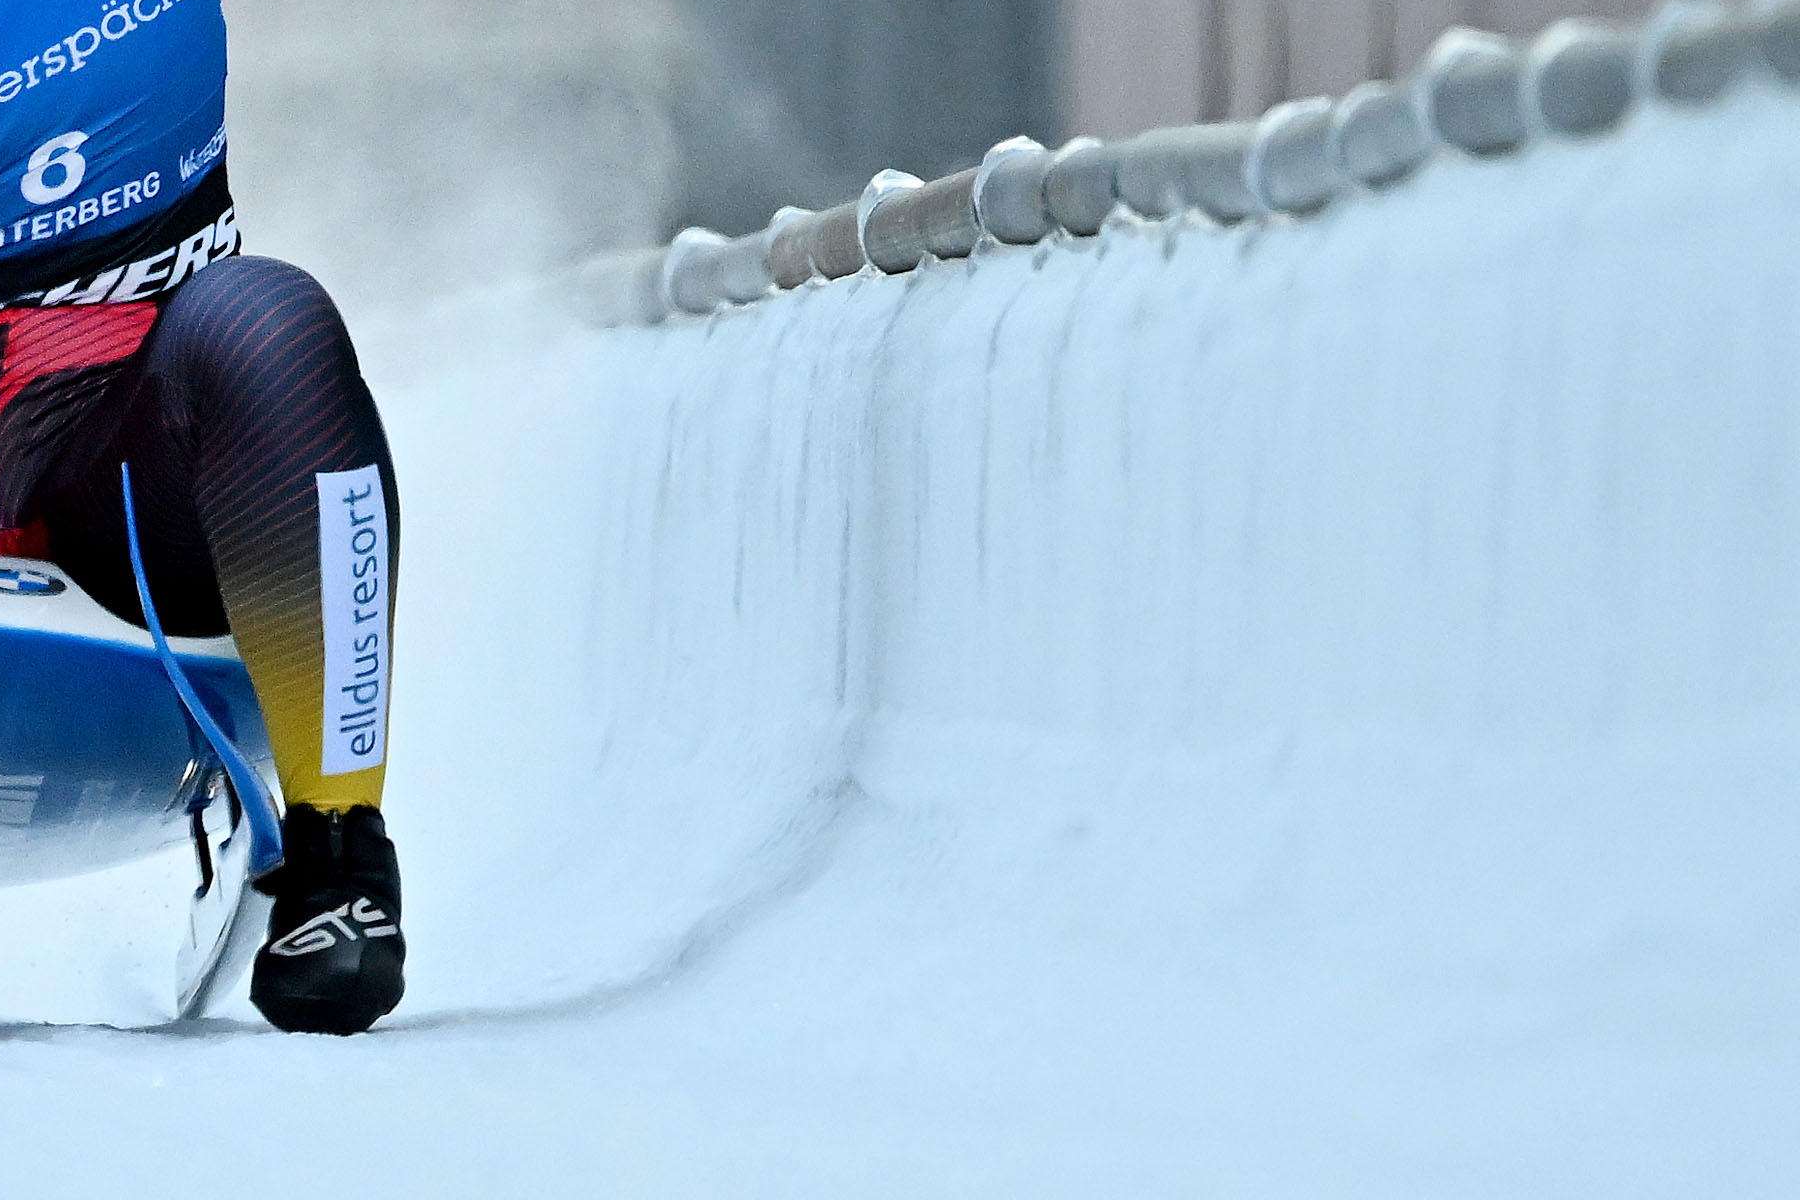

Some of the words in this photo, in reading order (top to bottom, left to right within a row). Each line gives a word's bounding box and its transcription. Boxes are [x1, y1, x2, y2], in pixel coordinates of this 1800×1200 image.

[20, 130, 90, 205] 6
[342, 483, 378, 626] resort
[339, 633, 379, 757] elldus
